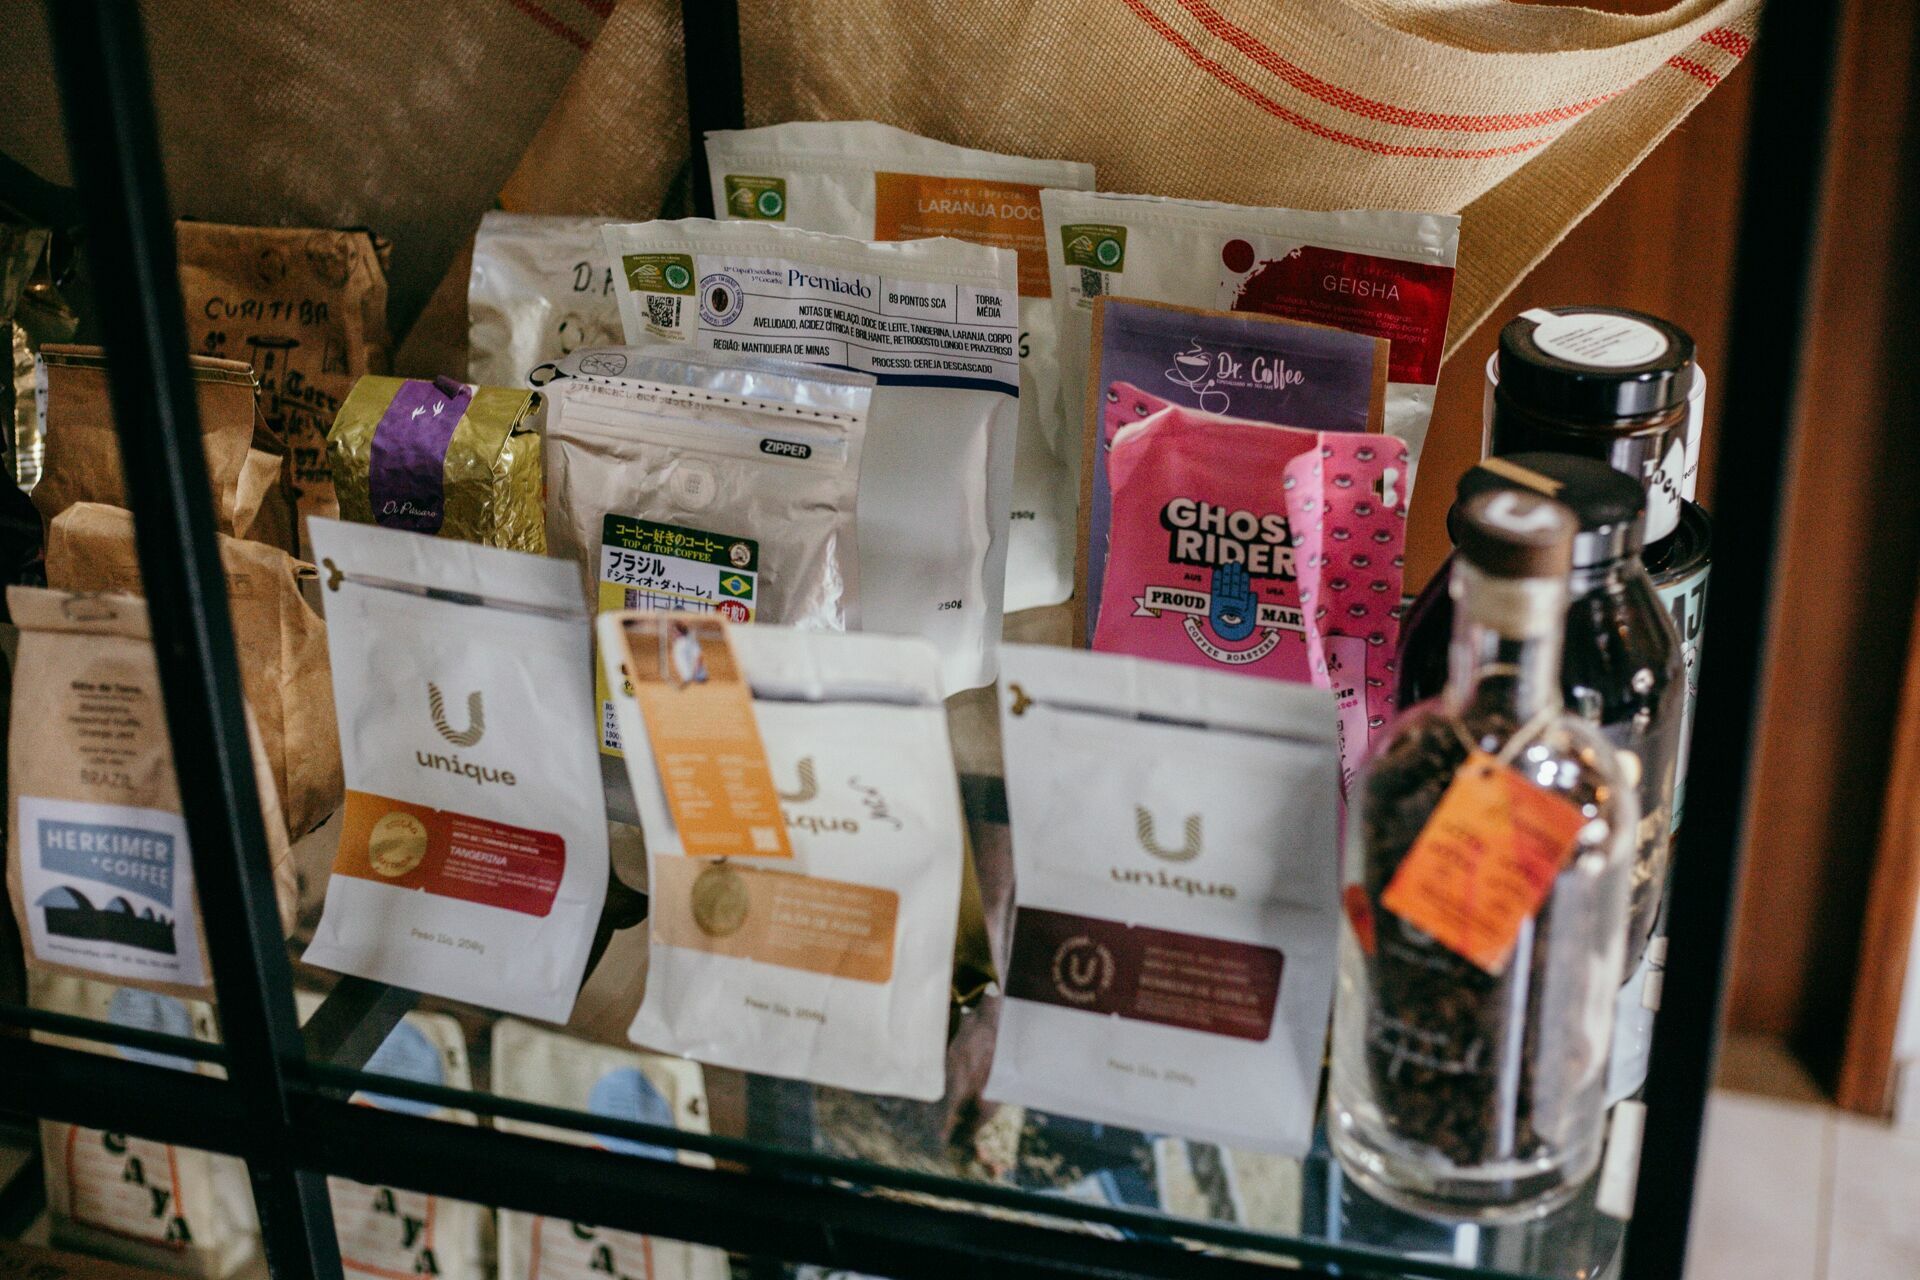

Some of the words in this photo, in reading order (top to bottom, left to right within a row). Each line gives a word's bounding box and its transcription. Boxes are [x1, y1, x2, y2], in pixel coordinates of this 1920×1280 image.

[918, 199, 997, 218] LARANJA
[1001, 204, 1041, 220] DOC
[788, 270, 872, 299] Premiado
[1323, 275, 1400, 301] GEISHA
[205, 297, 330, 326] CURITIBA
[888, 293, 899, 303] 89
[900, 294, 929, 308] PONTOS
[930, 298, 947, 308] SCA
[975, 294, 1003, 306] TORRA:
[976, 304, 1001, 318] MÉDIA
[753, 317, 798, 330] AVELUDADO,
[799, 319, 824, 330] ACIDEZ
[825, 321, 849, 335] CÍTRICA
[851, 327, 855, 337] E
[855, 329, 893, 345] BRILHANTE,
[893, 335, 940, 348] RETROGOSTO
[941, 340, 964, 351] LONGO
[965, 342, 969, 351] E
[970, 343, 1013, 356] PRAZEROSO
[799, 306, 823, 316] NOTAS
[824, 307, 833, 317] DE
[834, 310, 860, 326] MELAÇO,
[861, 318, 877, 330] DOCE
[878, 320, 887, 331] DE
[888, 321, 910, 333] LEITE,
[911, 324, 952, 338] TANGERINA,
[988, 333, 1012, 344] CORPO
[713, 338, 740, 351] REGIÃO:
[742, 341, 792, 354] MANTIQUEIRA
[794, 344, 804, 355] DE
[805, 345, 830, 356] MINAS
[872, 356, 912, 369] PROCESSO:
[913, 359, 942, 369] CEREJA
[943, 360, 993, 374] DESCASCADO
[1217, 352, 1242, 379] Dr.
[1252, 356, 1305, 390] Coffee
[764, 441, 808, 457] ZIPPER
[382, 500, 399, 515] Di
[1010, 511, 1035, 520] 250g
[1163, 497, 1290, 545] GHOS
[616, 524, 724, 552] コーヒー好きのコーヒー
[622, 538, 641, 549] TOP
[642, 542, 651, 551] of
[653, 544, 673, 555] TOP
[675, 548, 711, 562] COFFEE
[609, 551, 666, 577] ブラジル
[1174, 529, 1298, 578] RIDER
[938, 599, 962, 610] 250g
[1152, 591, 1206, 610] PROUD
[1188, 625, 1219, 658] COFFEE
[1227, 638, 1275, 662] ROASTERS
[416, 750, 517, 786] unique
[46, 829, 168, 863] HERKIMER
[451, 845, 507, 866] TANGERINA
[102, 857, 168, 889] COFFEE
[1110, 866, 1238, 899] unique
